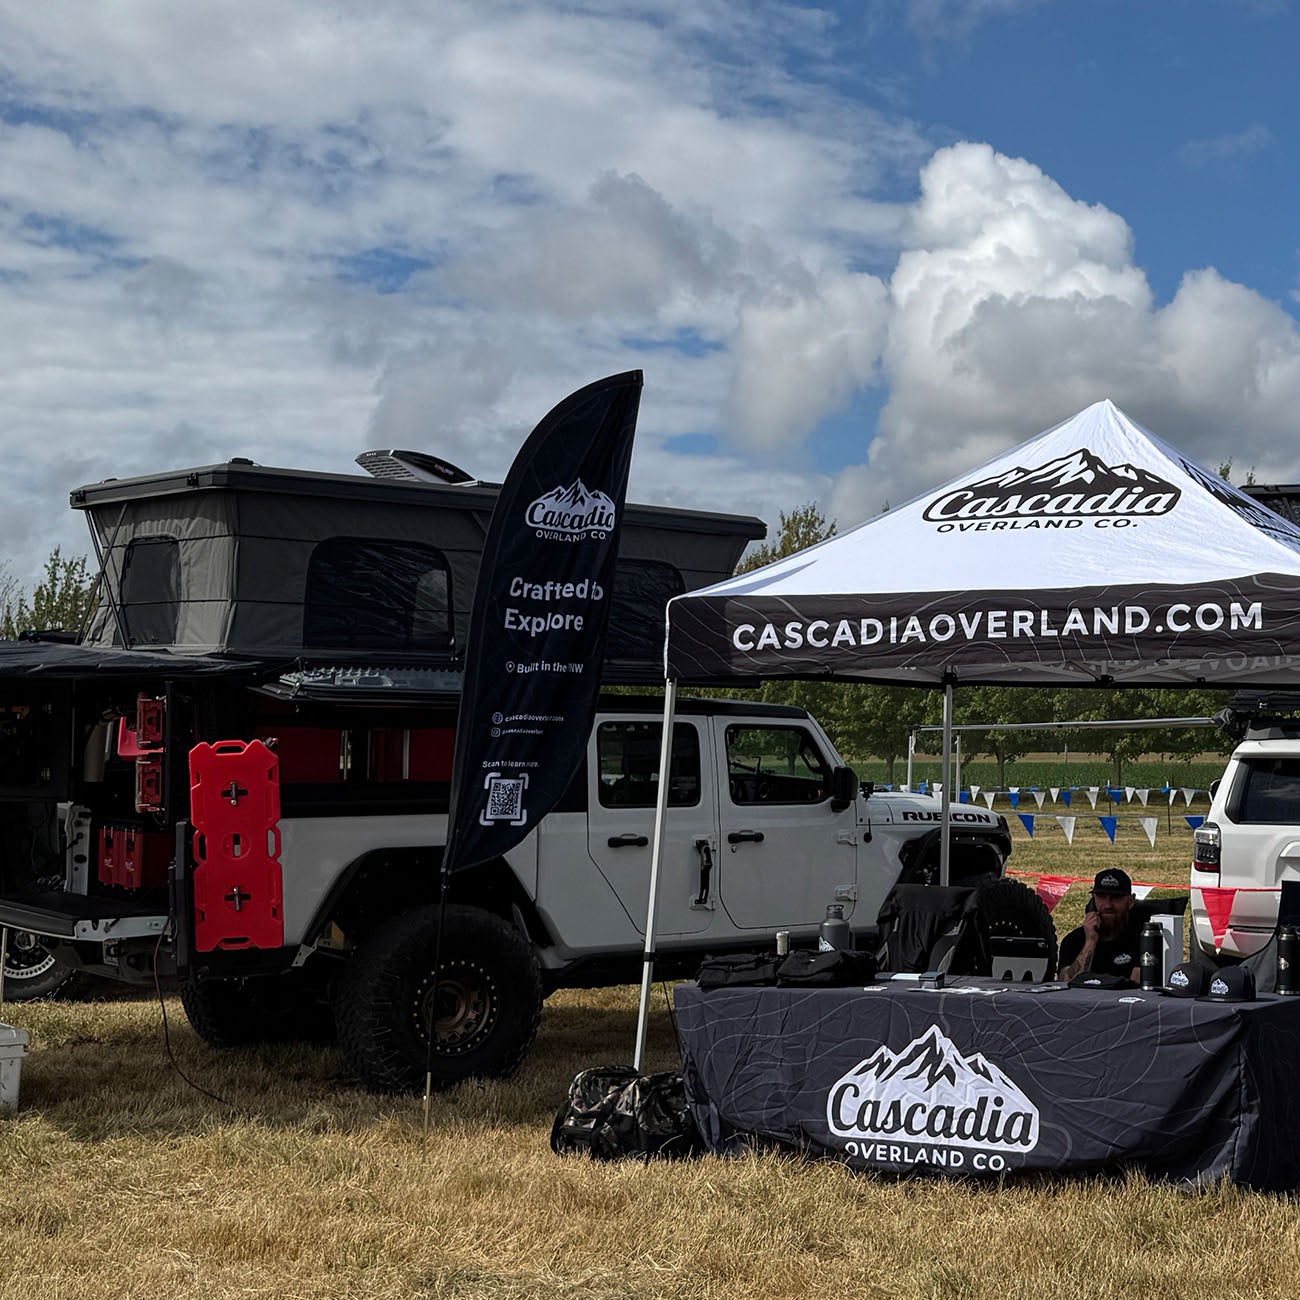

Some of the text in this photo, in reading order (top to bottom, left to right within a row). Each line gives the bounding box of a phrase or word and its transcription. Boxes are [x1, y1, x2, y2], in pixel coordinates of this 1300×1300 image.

[528, 502, 615, 530] Cascadia
[927, 485, 1176, 520] Cascadia
[535, 529, 587, 543] OVERLAND
[936, 518, 1138, 533] OVERLAND CO.
[509, 577, 590, 601] Crafted
[732, 601, 1263, 652] CASCADIAOVERLAND.COM
[541, 660, 551, 671] in
[831, 1082, 1034, 1146] Cascadia
[844, 1141, 1012, 1172] OVERLAND CO.
